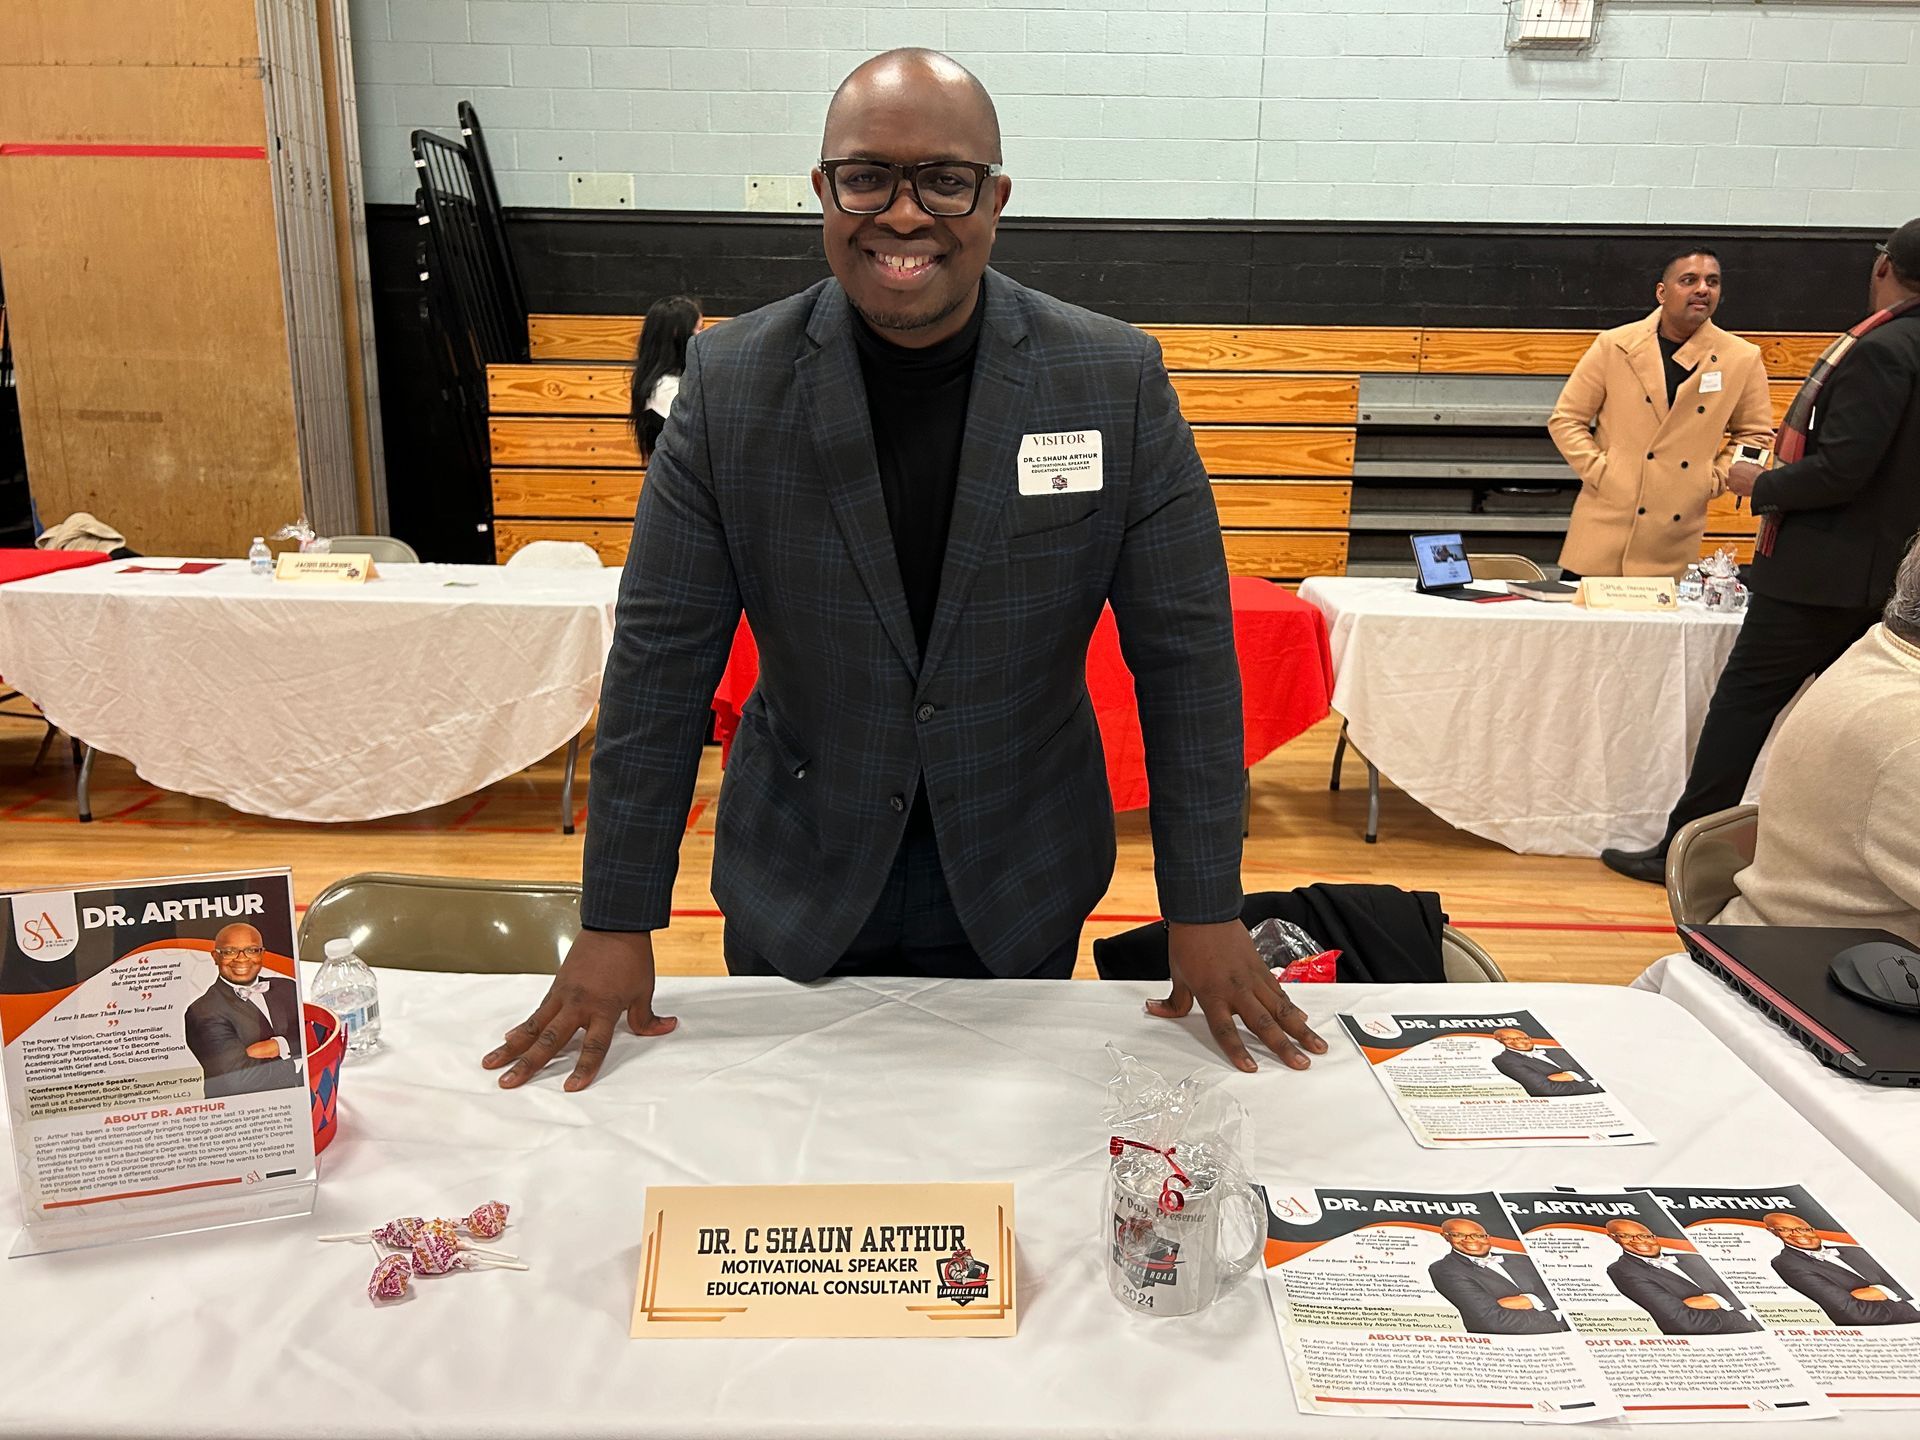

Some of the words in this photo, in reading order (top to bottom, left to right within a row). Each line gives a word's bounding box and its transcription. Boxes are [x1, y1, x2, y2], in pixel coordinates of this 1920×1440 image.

[1033, 433, 1086, 446] VISITOR
[1069, 452, 1098, 460] ARTHUR
[82, 901, 138, 929] DR.
[141, 893, 264, 924] ARTHUR
[143, 982, 166, 990] ground
[146, 1004, 166, 1012] Found
[1399, 1019, 1436, 1029] DR.
[1439, 1017, 1520, 1029] ARTHUR
[95, 1030, 126, 1038] Charting
[127, 1026, 163, 1034] Unfamiliar
[72, 1039, 112, 1047] Importance
[24, 1058, 71, 1067] Academically
[150, 1044, 186, 1053] Emotional
[25, 1067, 56, 1075] Learning
[128, 1054, 168, 1063] Discovering
[26, 1073, 62, 1082] Emotional
[63, 1069, 105, 1077] Intelligence.
[29, 1093, 64, 1101] Workshop
[155, 1079, 177, 1088] Arthur
[178, 1075, 202, 1083] Today!
[74, 1081, 104, 1089] Keynote
[68, 1102, 101, 1111] Reserved
[152, 1094, 172, 1102] Moon
[173, 1091, 190, 1099] LLC.)
[104, 1111, 147, 1124] ABOUT
[150, 1109, 172, 1118] DR.
[175, 1102, 224, 1115] ARTHUR
[1127, 1197, 1149, 1219] Day
[1322, 1197, 1368, 1212] DR.
[1373, 1199, 1481, 1215] ARTHUR
[1503, 1201, 1529, 1214] R.
[1534, 1200, 1640, 1216] ARTHUR
[1655, 1196, 1685, 1209] R.
[1688, 1195, 1796, 1210] ARTHUR
[698, 1227, 736, 1255] DR.
[745, 1228, 758, 1254] C
[766, 1226, 854, 1254] SHAUN
[860, 1225, 966, 1253] ARTHUR
[721, 1259, 843, 1274] MOTIVATIONAL
[848, 1257, 918, 1273] SPEAKER
[1149, 1271, 1174, 1281] ROAD
[707, 1281, 819, 1296] EDUCATIONAL
[823, 1279, 931, 1295] CONSULTANT
[1123, 1284, 1154, 1308] 2024
[1368, 1333, 1411, 1341] ABOUT
[1440, 1336, 1492, 1344] ARTHUR
